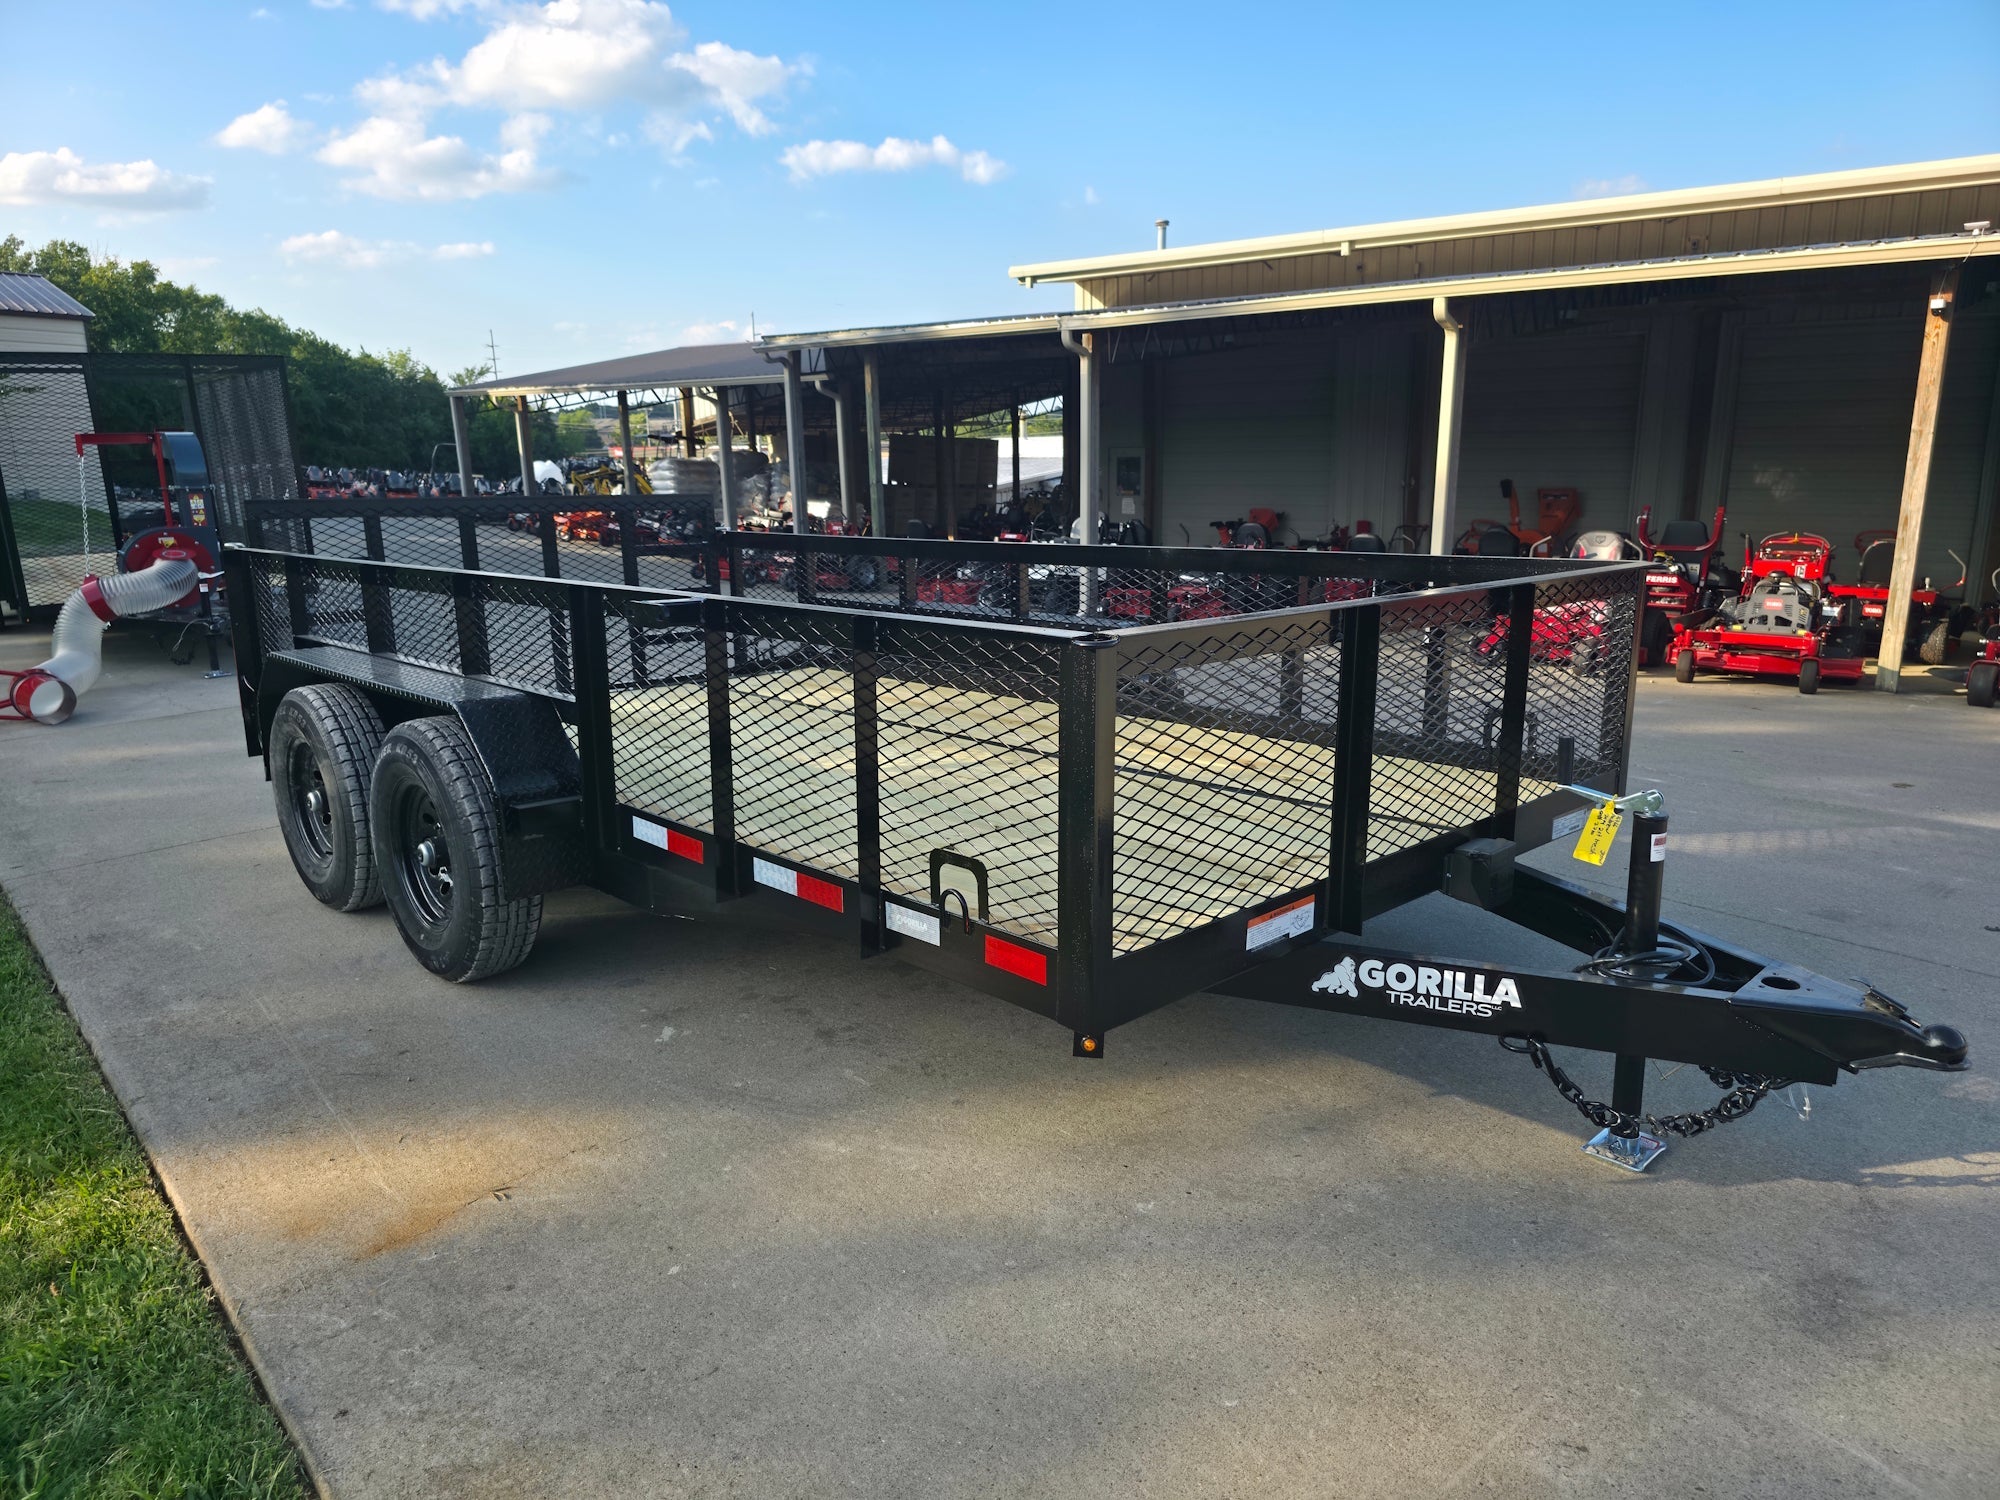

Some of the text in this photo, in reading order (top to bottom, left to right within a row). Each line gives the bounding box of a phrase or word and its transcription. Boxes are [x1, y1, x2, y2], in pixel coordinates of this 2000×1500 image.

[1645, 575, 1678, 584] FERRIS
[1358, 959, 1522, 1009] GORILLA
[1386, 990, 1493, 1017] TRAILERS
